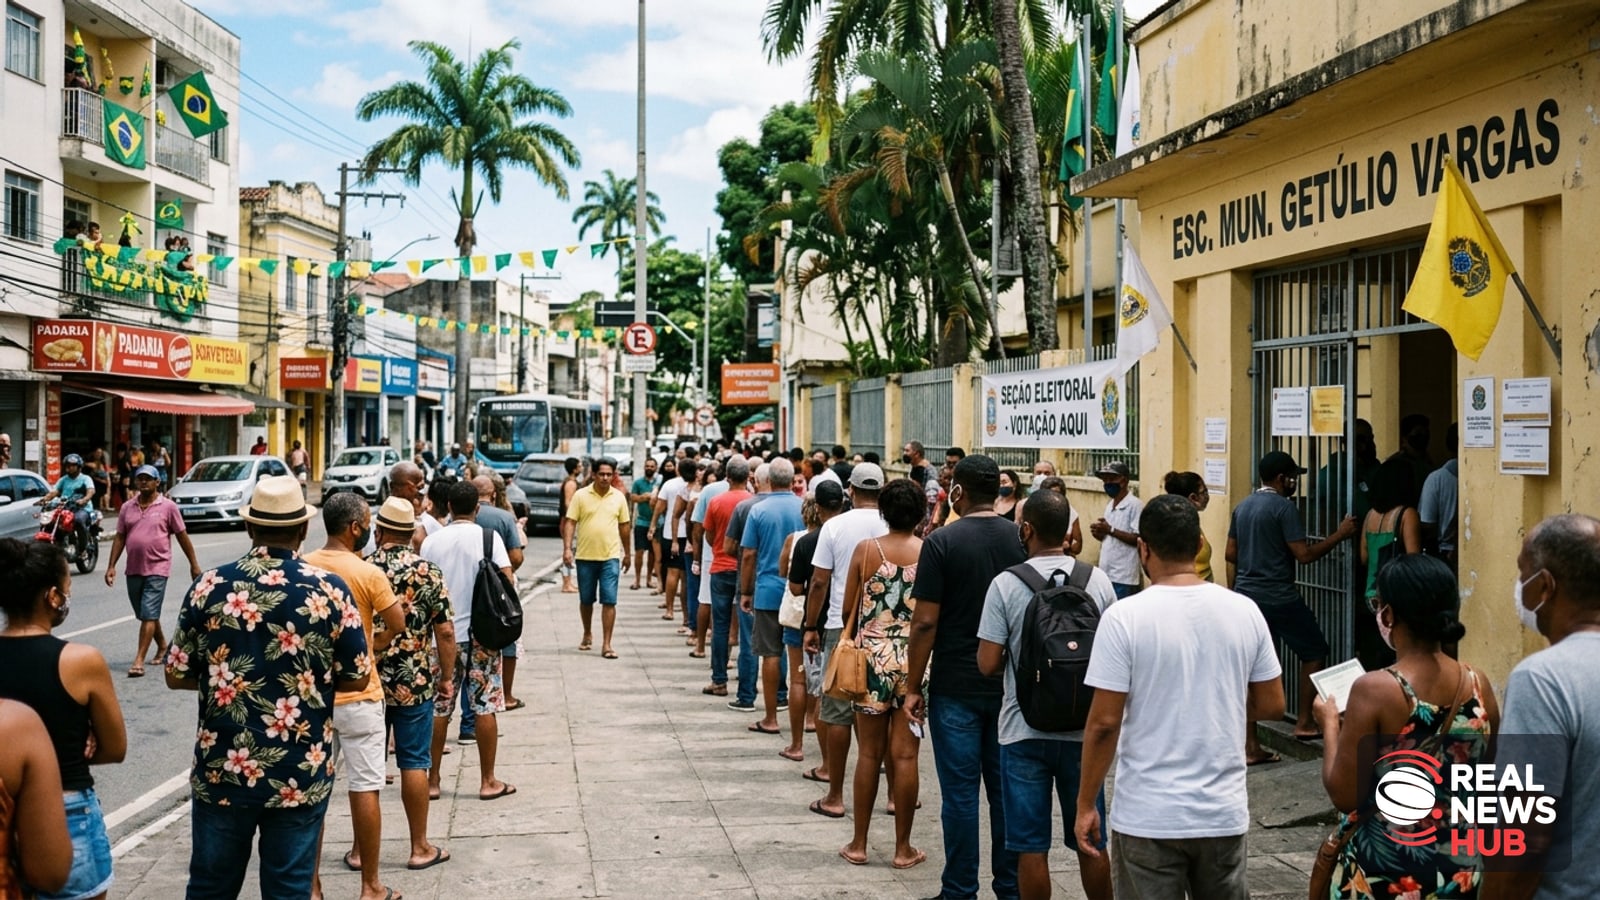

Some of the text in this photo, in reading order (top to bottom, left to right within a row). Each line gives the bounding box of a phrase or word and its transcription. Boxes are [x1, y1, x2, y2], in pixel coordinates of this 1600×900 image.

[1172, 98, 1560, 260] ESC. MUN. GETÚLIO VARGAS
[37, 325, 89, 336] PADARIA
[118, 332, 165, 358] PADARIA
[1034, 375, 1096, 403] ELEITORAL
[1059, 411, 1088, 437] AQUI
